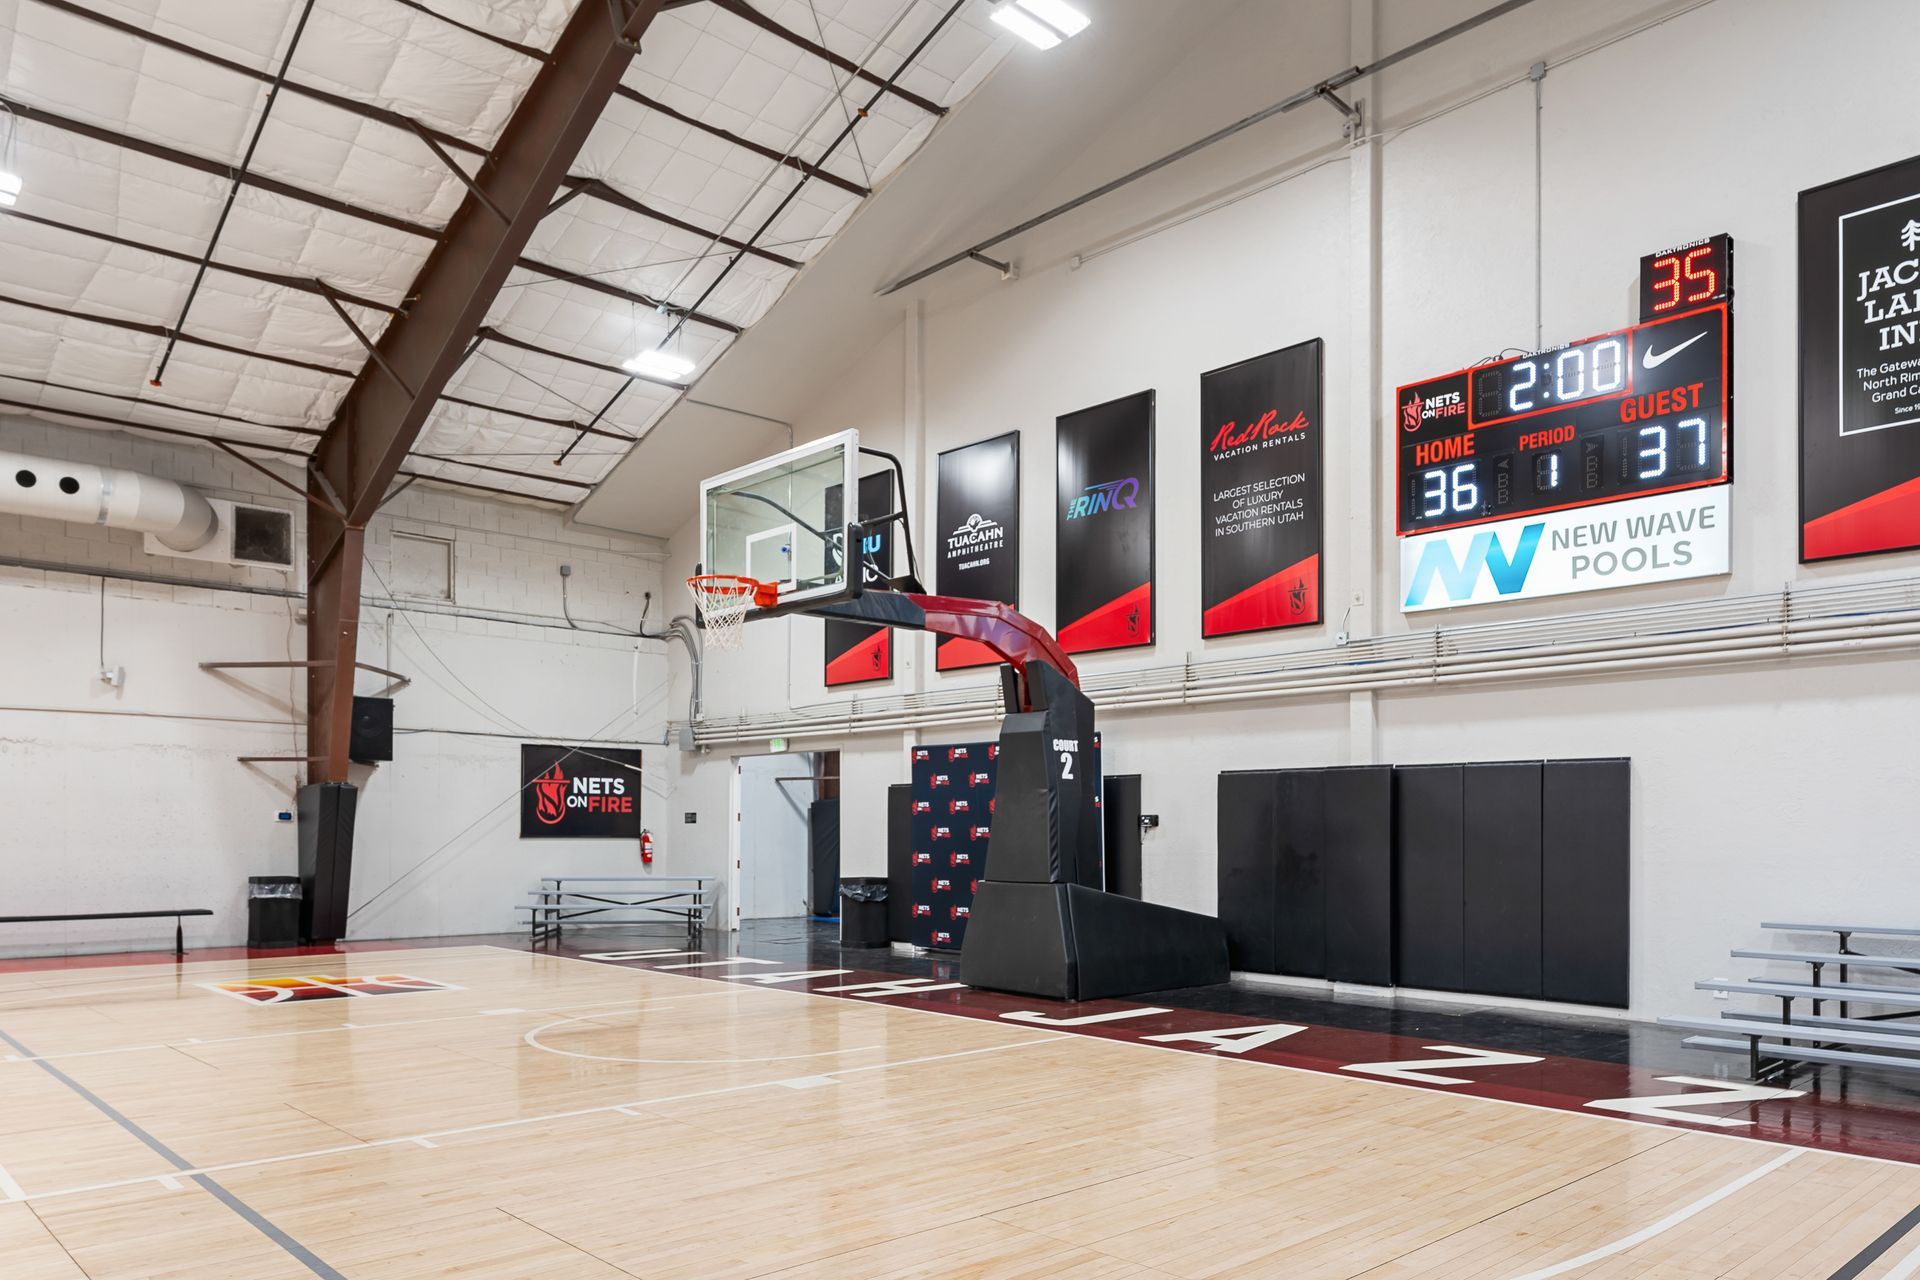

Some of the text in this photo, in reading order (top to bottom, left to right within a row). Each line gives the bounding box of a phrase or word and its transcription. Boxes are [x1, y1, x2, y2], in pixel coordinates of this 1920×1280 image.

[1653, 246, 1716, 311] 35
[1856, 258, 1920, 302] JAC
[1879, 320, 1920, 351] IN
[1509, 340, 1621, 412] 2:00
[1856, 367, 1877, 379] The
[1863, 375, 1898, 391] North
[1425, 391, 1460, 409] NETS
[1620, 382, 1704, 423] GUEST
[1871, 387, 1907, 403] Grand
[1421, 402, 1466, 419] ON FIRE
[1894, 405, 1914, 415] Since
[1209, 409, 1310, 452] Red Rock
[1519, 425, 1575, 452] PERIOD
[1213, 431, 1306, 461] VACATION RENTALS
[1415, 433, 1476, 467] HOME
[1639, 417, 1706, 479] 37
[1550, 454, 1558, 487] 1
[1073, 477, 1138, 519] RINQ
[1213, 472, 1305, 502] LARGEST SELECTION
[1232, 489, 1284, 509] OF LUXURY
[1424, 463, 1478, 517] 36
[1215, 498, 1304, 525] VACATION RENTALS
[1215, 510, 1304, 537] IN SOUTHERN UTAH
[947, 526, 1004, 549] TUACAHN
[1551, 505, 1717, 551] NEW WAVE
[947, 539, 1004, 559] AMPHITHEATRE
[1571, 540, 1693, 579] POOLS
[1052, 738, 1079, 752] COURT
[1060, 752, 1074, 780] 2
[573, 776, 625, 795] NETS
[566, 795, 633, 813] ON FIRE
[579, 948, 1808, 1128] UTAH JAZZ
